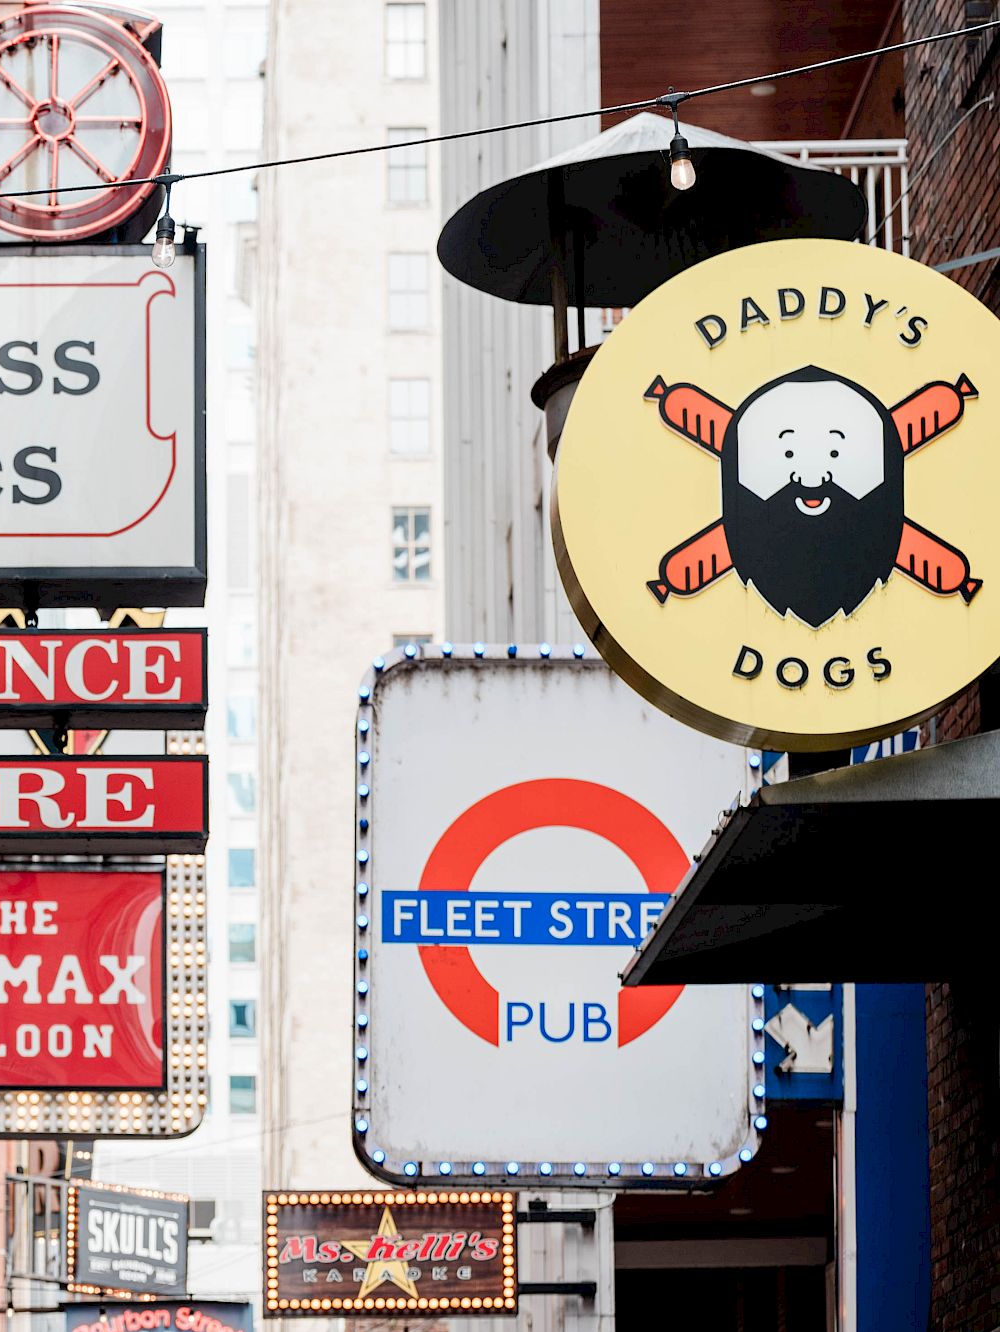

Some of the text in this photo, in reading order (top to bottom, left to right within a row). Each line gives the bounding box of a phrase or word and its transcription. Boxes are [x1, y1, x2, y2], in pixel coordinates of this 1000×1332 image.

[694, 286, 929, 351] DADDY'S
[732, 645, 893, 690] DOGS
[393, 899, 533, 938] FLEET
[506, 1002, 612, 1043] PUB
[87, 1208, 180, 1265] SKULL'S
[279, 1236, 354, 1264] Ms.
[302, 1266, 472, 1283] KARAOKE
